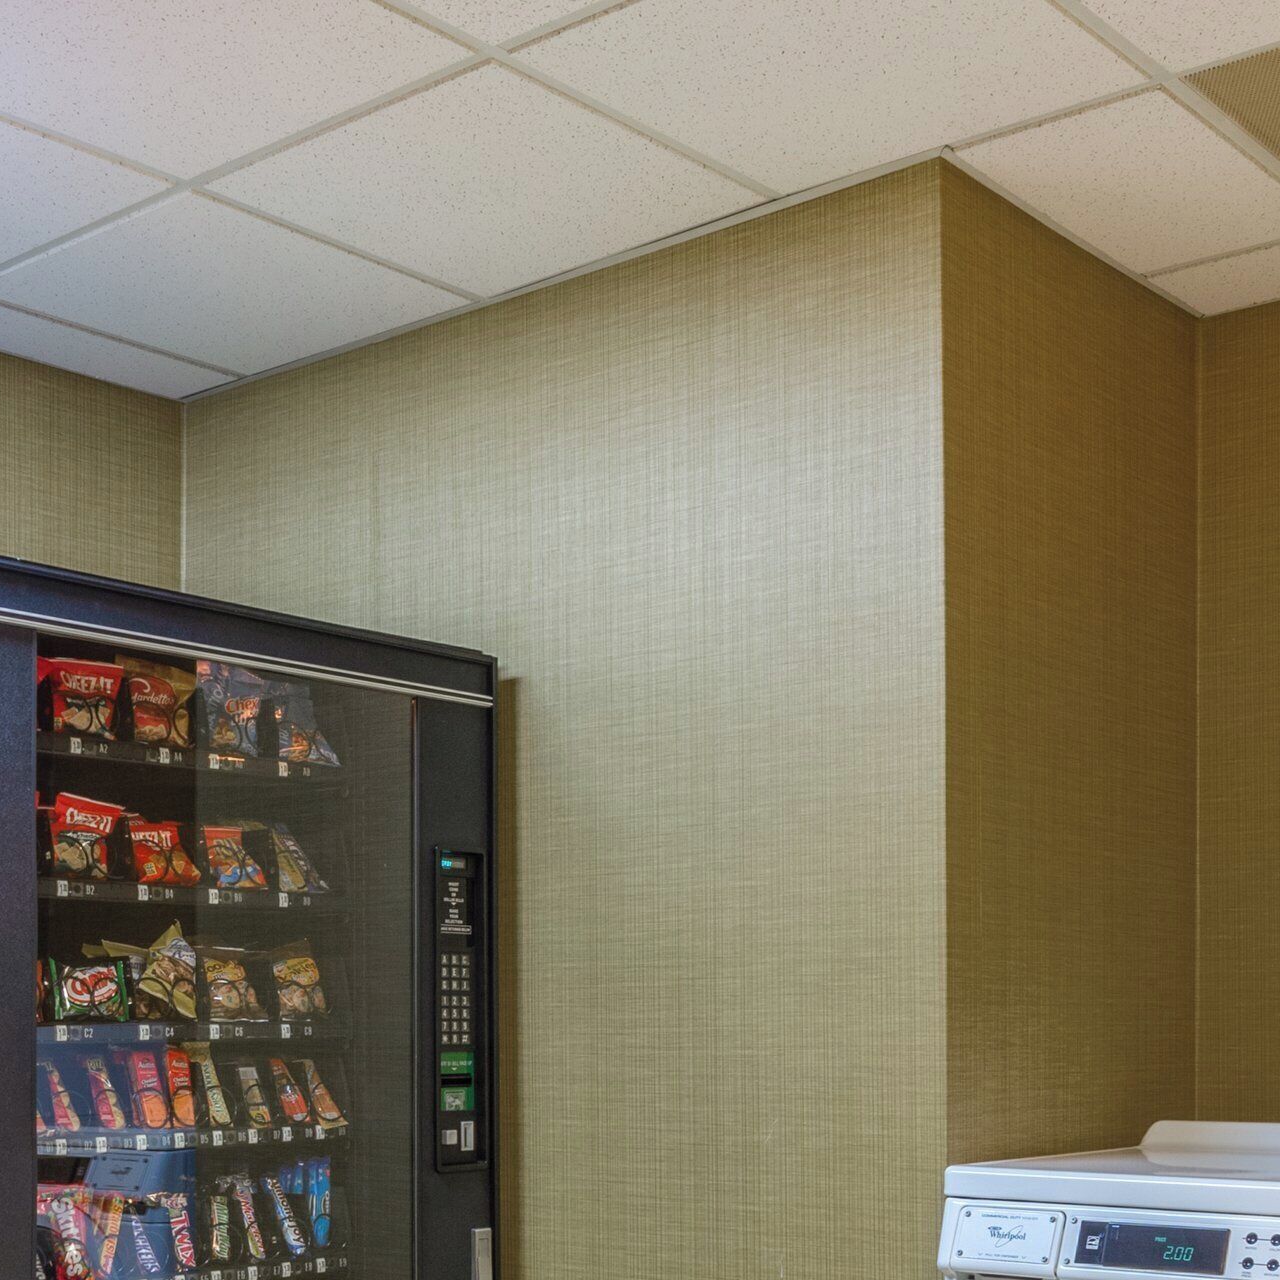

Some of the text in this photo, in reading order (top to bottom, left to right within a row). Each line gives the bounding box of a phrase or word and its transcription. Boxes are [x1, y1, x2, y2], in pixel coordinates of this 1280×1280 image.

[225, 697, 259, 714] Chex
[99, 743, 108, 753] A2
[174, 752, 183, 763] A4
[86, 885, 95, 895] B2
[165, 888, 174, 899] B4
[84, 1028, 93, 1038] C2
[165, 1026, 174, 1038] C4
[235, 1026, 244, 1037] C6
[123, 1138, 133, 1148] D3
[200, 1134, 209, 1144] D5
[170, 1210, 197, 1268] TWIX
[989, 1230, 1027, 1242] Whirlpool
[1163, 1245, 1194, 1262] 2.00
[237, 1270, 246, 1280] E6
[273, 1266, 281, 1275] E7
